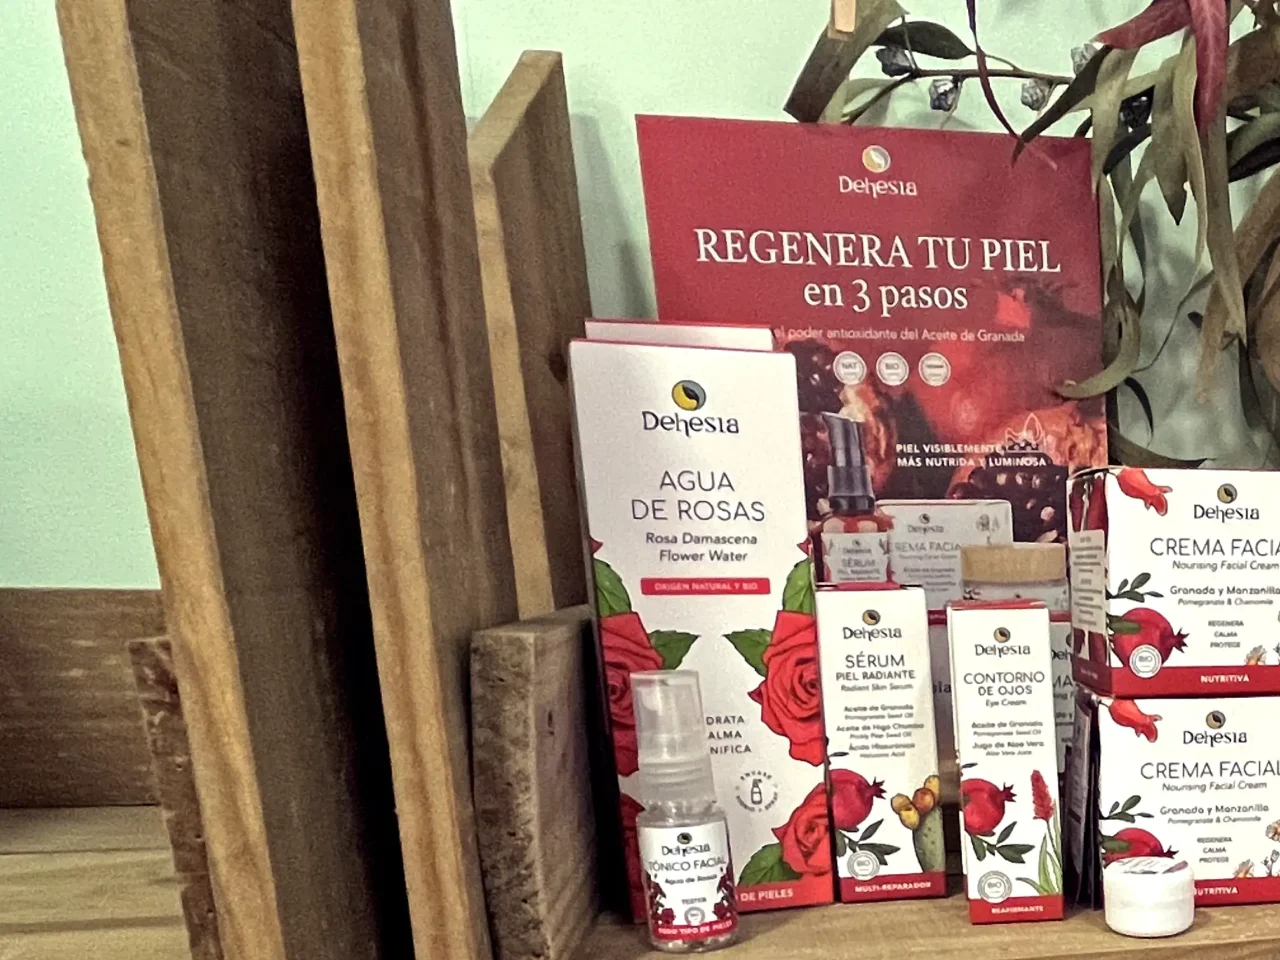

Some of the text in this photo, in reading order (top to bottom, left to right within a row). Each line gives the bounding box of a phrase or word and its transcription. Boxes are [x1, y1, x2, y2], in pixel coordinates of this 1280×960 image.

[839, 175, 917, 197] Dehesia
[694, 228, 1061, 273] REGENERA TU PIEL
[804, 279, 968, 317] en 3 pasos
[788, 328, 822, 340] poder
[827, 329, 897, 340] antioxidante
[900, 329, 919, 340] del
[922, 330, 957, 340] Aceite
[961, 331, 974, 341] de
[978, 330, 1024, 342] Granada
[642, 410, 739, 437] Dehesia
[896, 444, 919, 453] PIEL
[897, 457, 921, 467] MÁS
[926, 458, 975, 467] NUTRIDA
[989, 457, 1046, 467] LUMINOSA
[660, 470, 735, 491] AGUA
[632, 500, 765, 522] DE ROSAS
[1194, 504, 1259, 522] Dehesia
[646, 532, 757, 544] Rosa Damascena
[1150, 538, 1225, 556] CREMA
[660, 550, 748, 561] Flower Water
[692, 582, 733, 590] NATURAL
[843, 627, 902, 641] Dehesia
[846, 651, 905, 668] SÉRUM
[836, 670, 916, 681] PIEL RADIANTE
[964, 671, 1045, 684] CONTORNO
[1201, 674, 1249, 682] NUTRITIVA
[978, 685, 1032, 696] DE OJOS
[706, 716, 745, 725] DRATA
[708, 730, 742, 739] ALMA
[1183, 730, 1247, 747] Dehesia
[710, 745, 751, 754] NIFICA
[1141, 762, 1213, 779] CREMA
[649, 857, 725, 872] TÓNICO FACIAL
